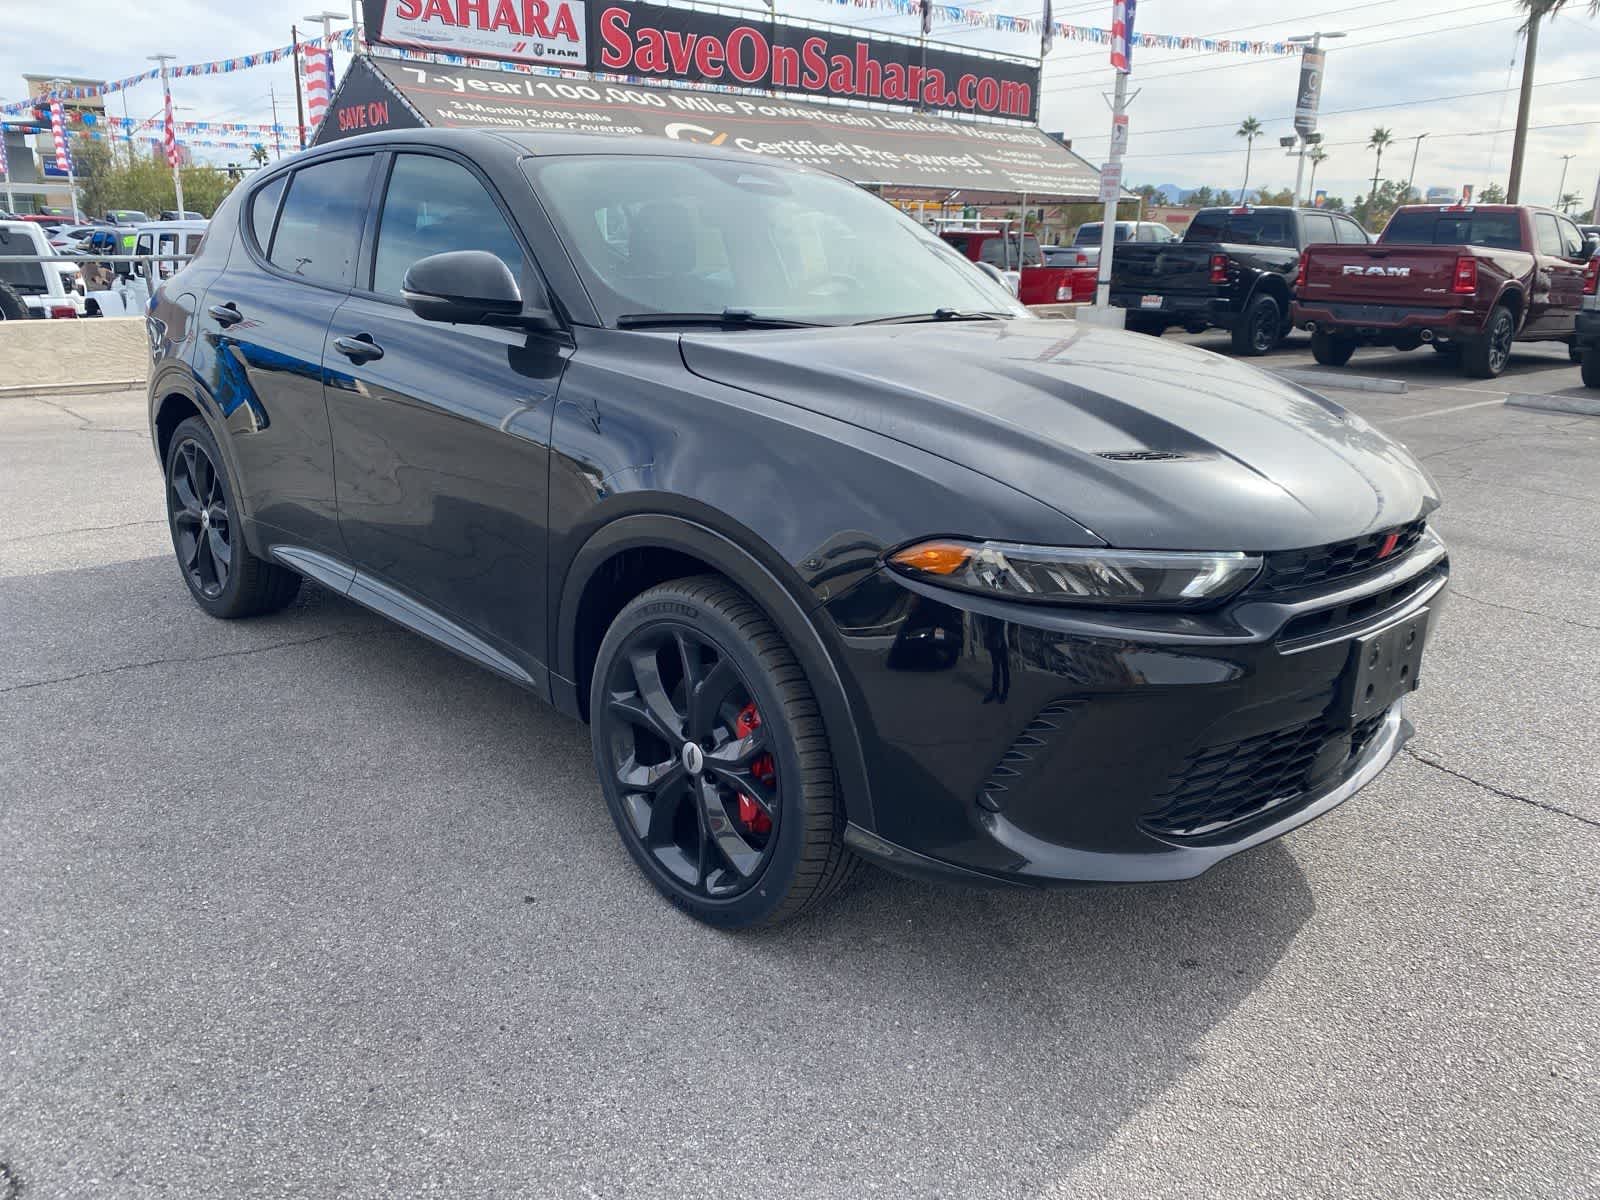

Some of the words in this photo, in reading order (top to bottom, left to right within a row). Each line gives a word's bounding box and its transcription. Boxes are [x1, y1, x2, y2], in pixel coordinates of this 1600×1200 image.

[396, 0, 580, 42] SAHARA
[547, 48, 579, 57] RAM
[600, 7, 1032, 118] SaveOnSahara.com
[338, 104, 367, 131] SAVE
[367, 100, 389, 126] ON
[436, 108, 525, 128] Maximum
[528, 119, 566, 130] Care
[567, 121, 644, 135] Coverage
[668, 94, 736, 114] Mile
[736, 101, 876, 128] Powertrain
[875, 116, 958, 135] Limited
[954, 125, 1047, 147] Warranty
[735, 137, 854, 157] Certified
[852, 143, 983, 167] Pre-owned
[1343, 265, 1411, 276] RAM
